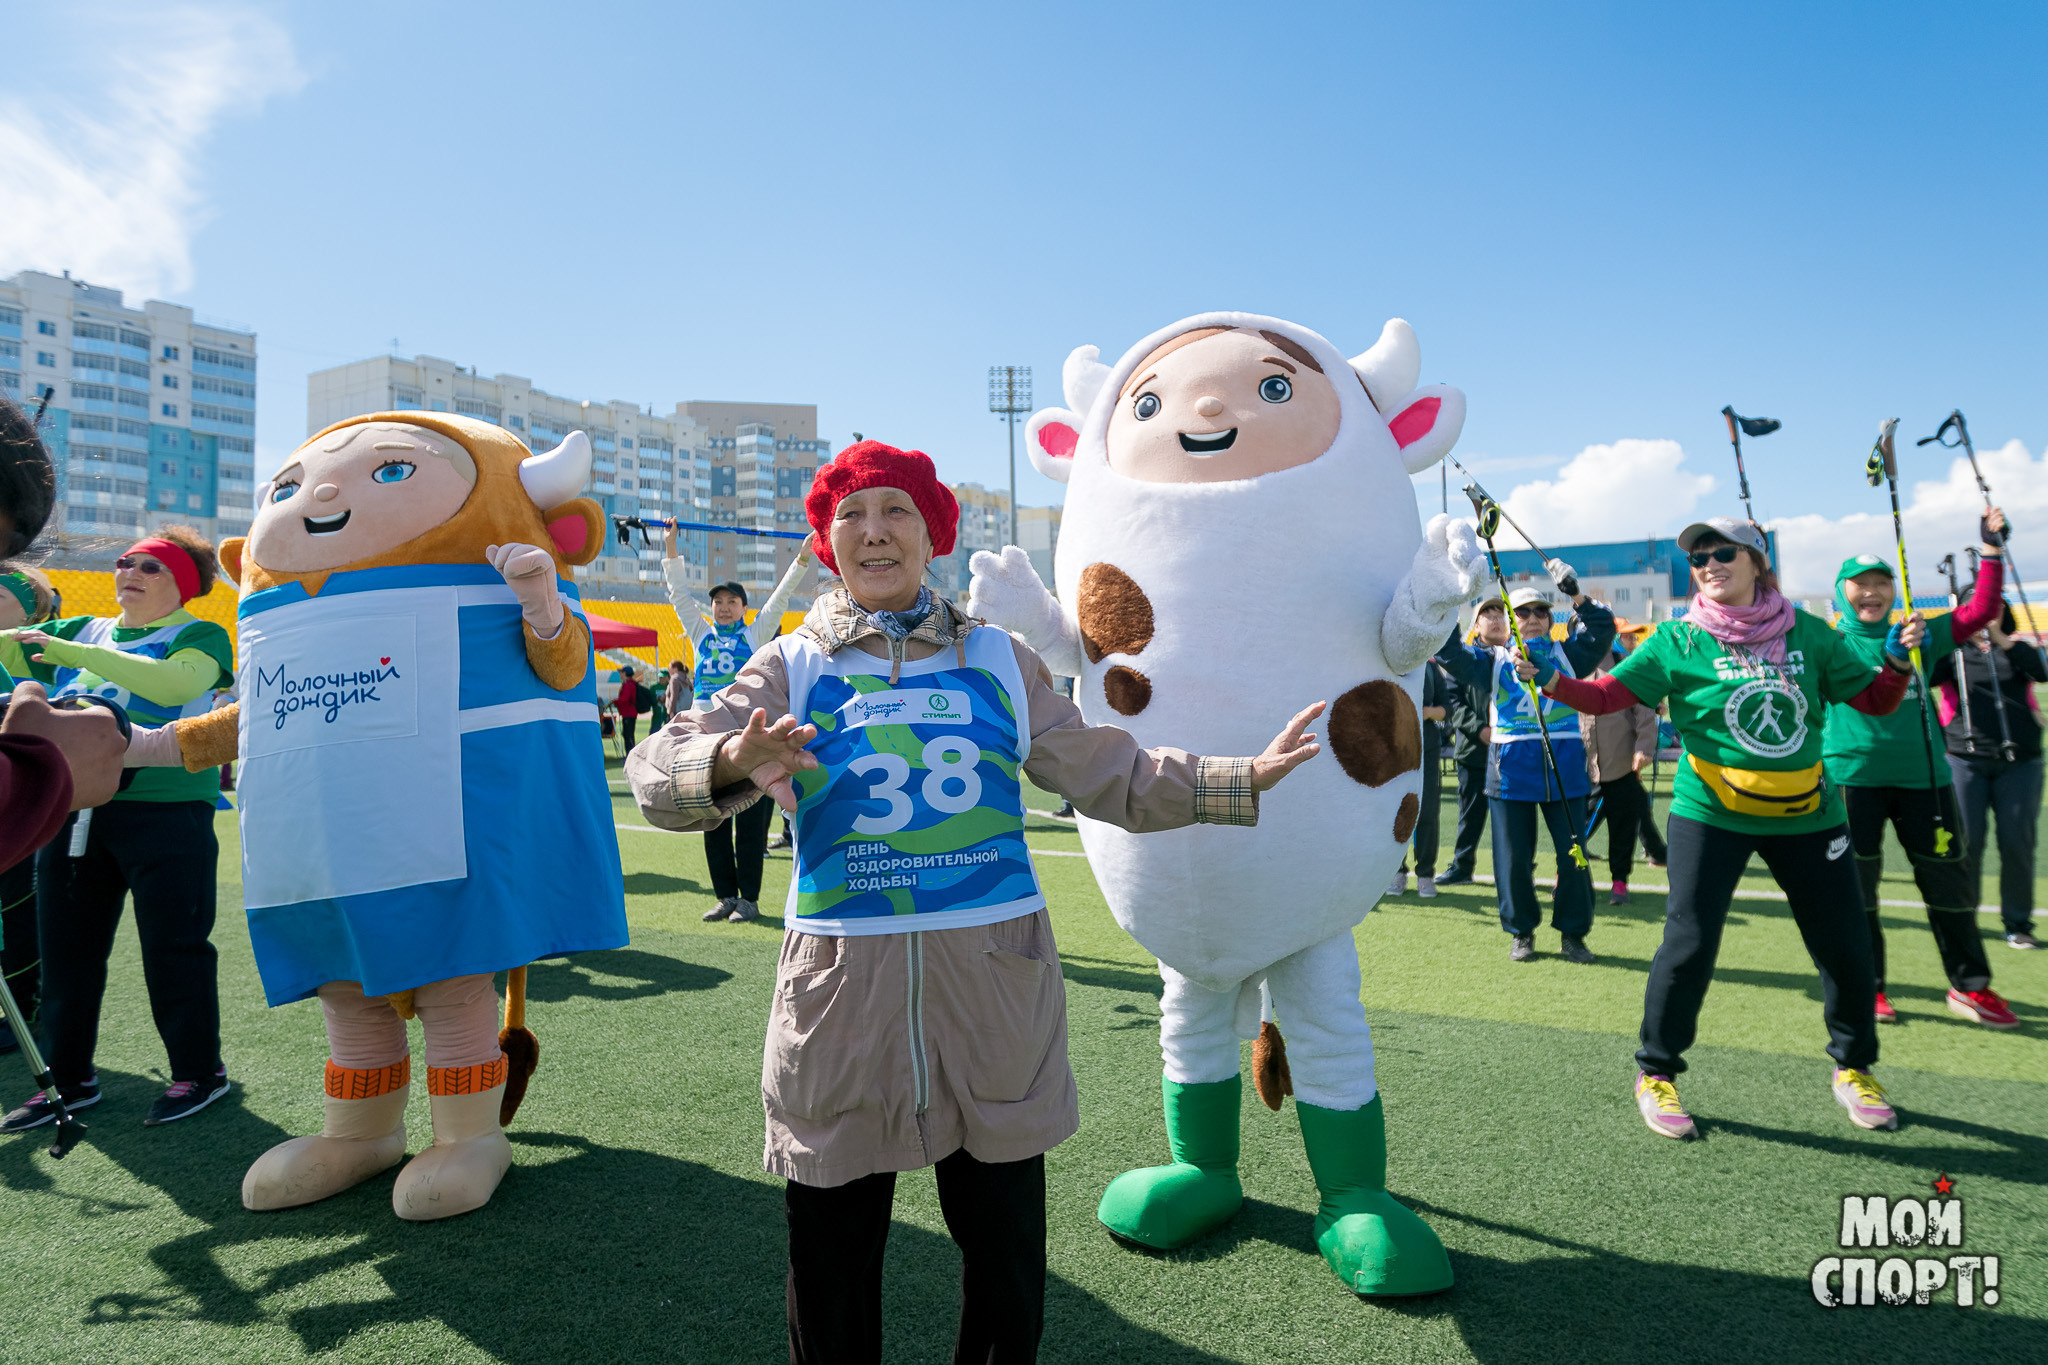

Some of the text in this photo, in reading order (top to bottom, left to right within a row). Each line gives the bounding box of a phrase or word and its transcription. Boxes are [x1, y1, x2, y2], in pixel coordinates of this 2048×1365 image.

[702, 651, 736, 675] 18
[257, 657, 401, 698] Молочный
[273, 686, 381, 730] дождик
[863, 706, 902, 720] дождик
[847, 735, 983, 836] 38
[846, 842, 889, 858] ДЕНЬ
[847, 848, 999, 874] ОЗДОРОВИТЕЛЬНОЙ
[848, 874, 917, 891] ХОДЬБЫ
